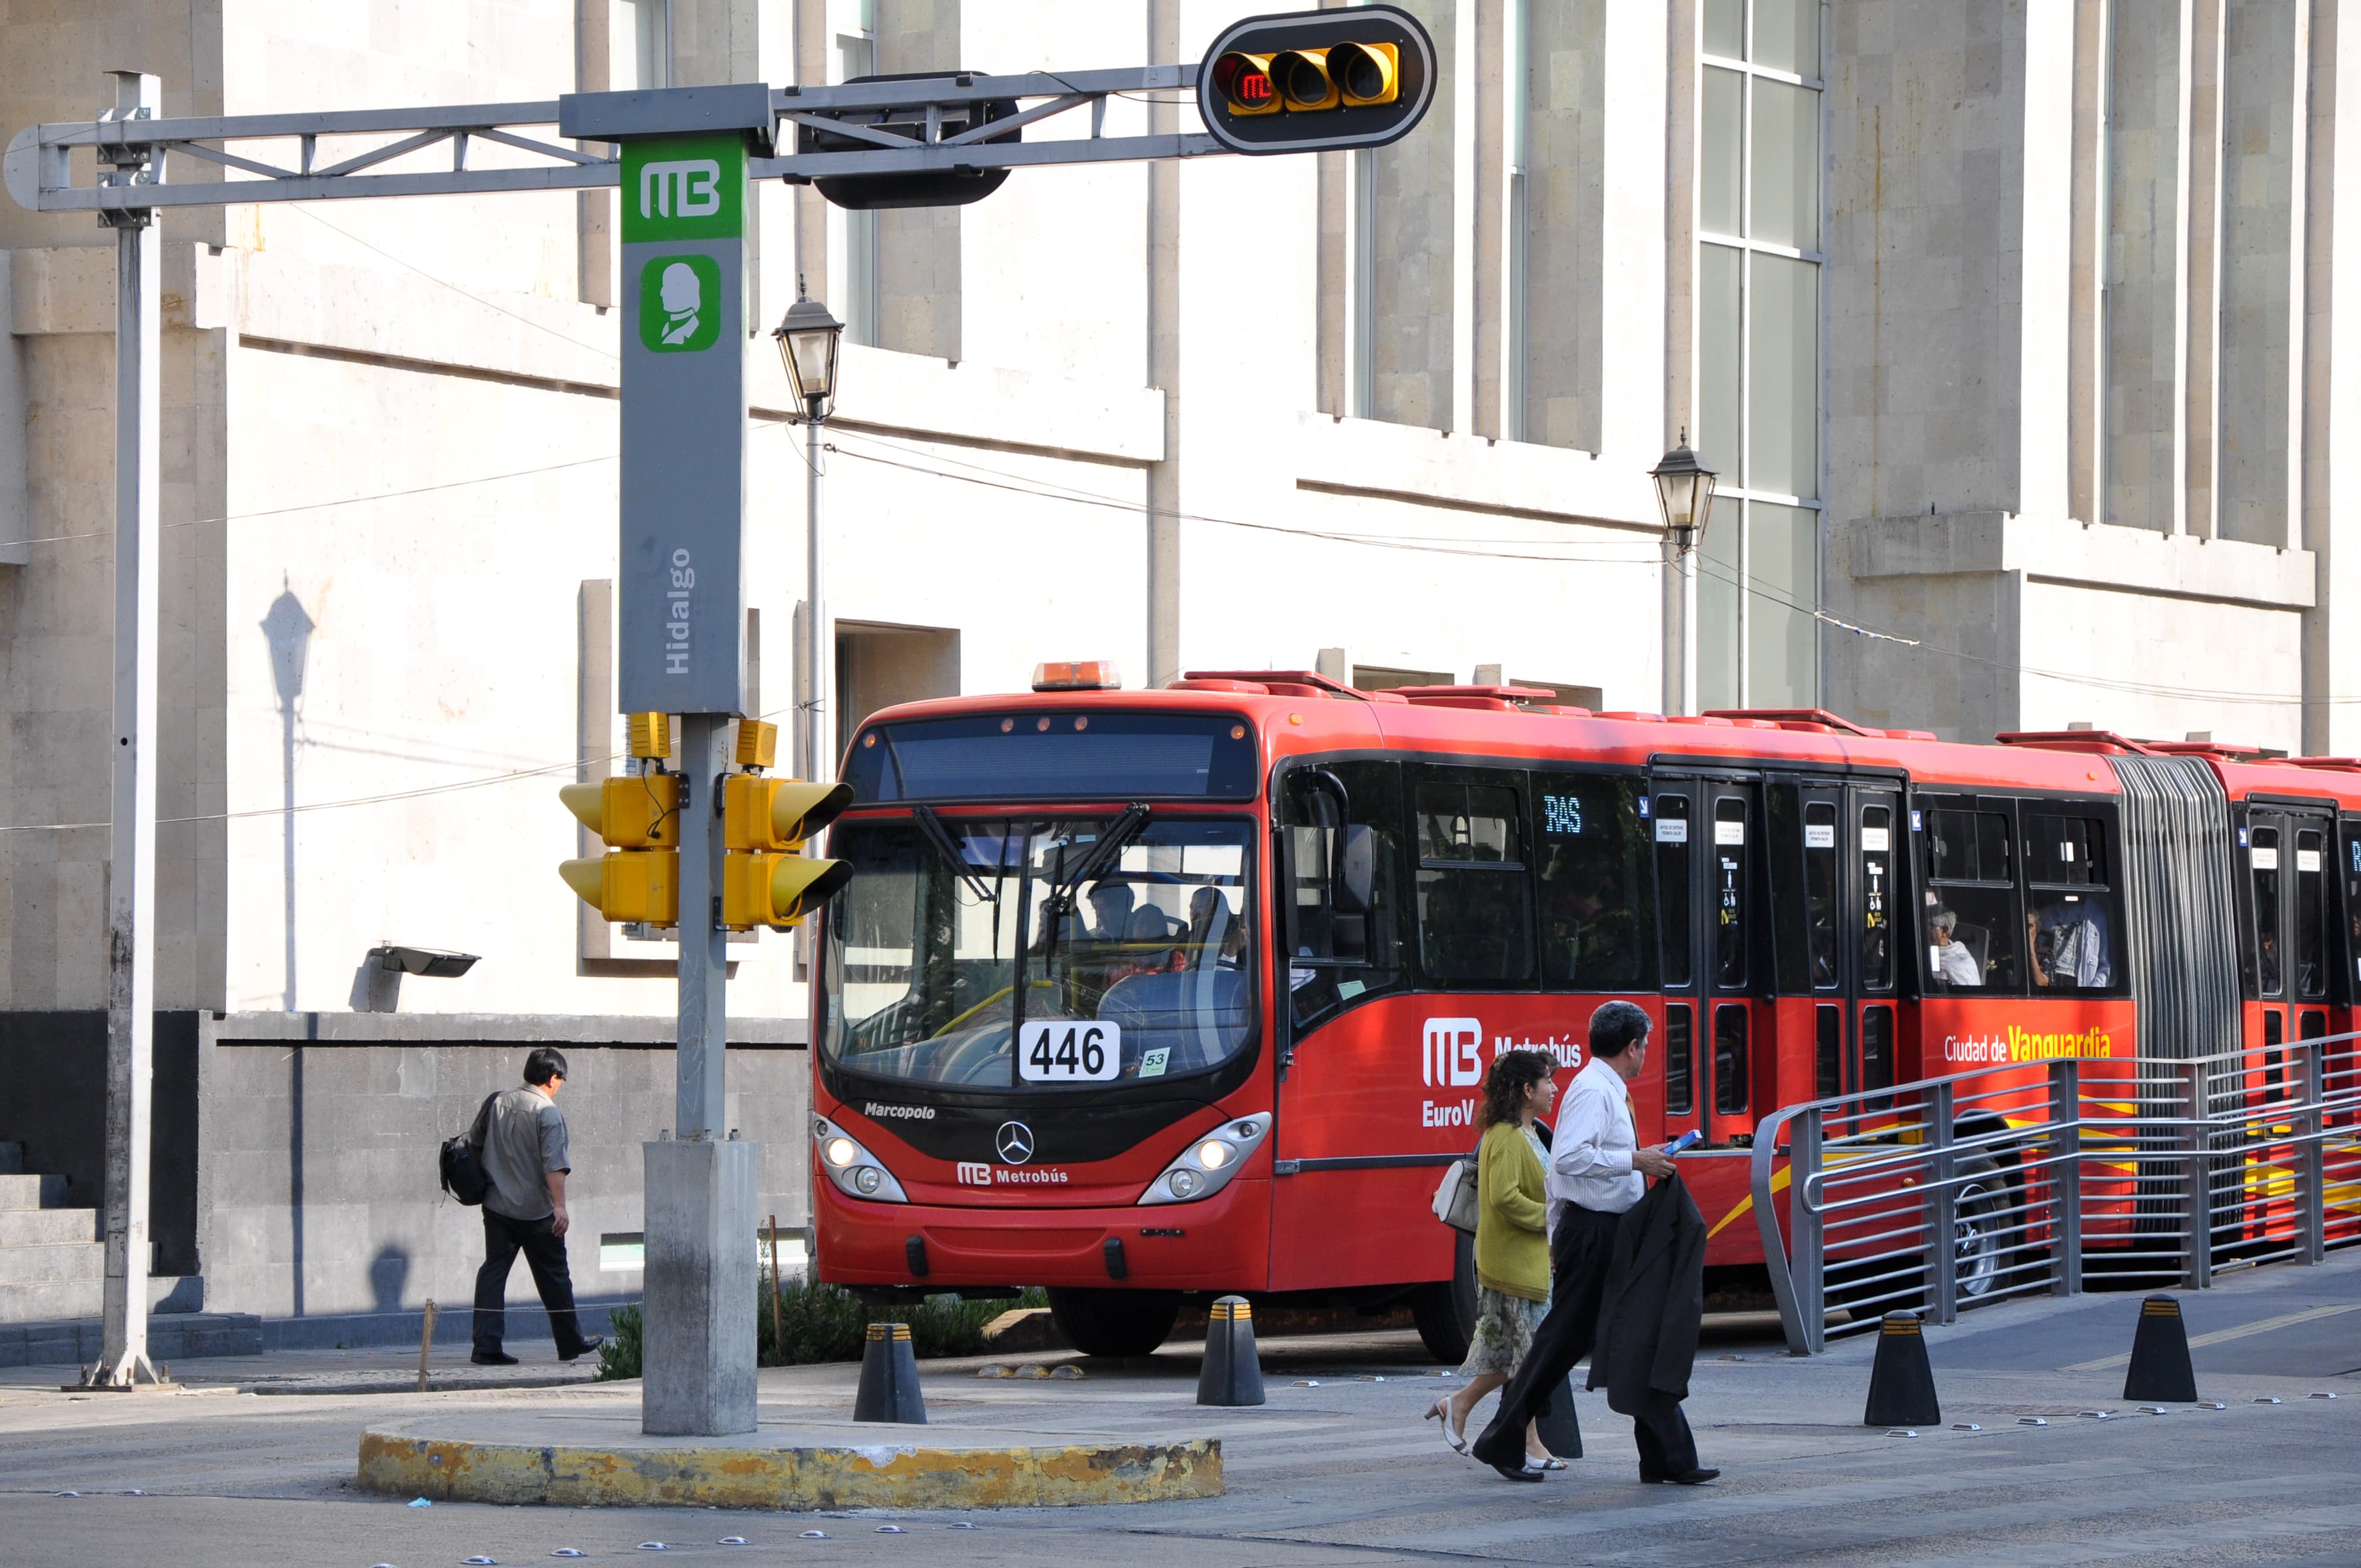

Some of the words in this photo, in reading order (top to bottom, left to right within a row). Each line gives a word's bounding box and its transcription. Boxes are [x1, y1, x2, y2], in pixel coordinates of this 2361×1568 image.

[666, 548, 695, 675] Hidalgo
[1030, 1028, 1104, 1074] 446
[1146, 1054, 1165, 1066] 53
[1945, 1034, 1988, 1062] Ciudad
[1990, 1035, 2006, 1062] de
[864, 1102, 936, 1120] Marcopolo
[1423, 1099, 1475, 1128] EuroV
[996, 1168, 1068, 1183] Metrobús
